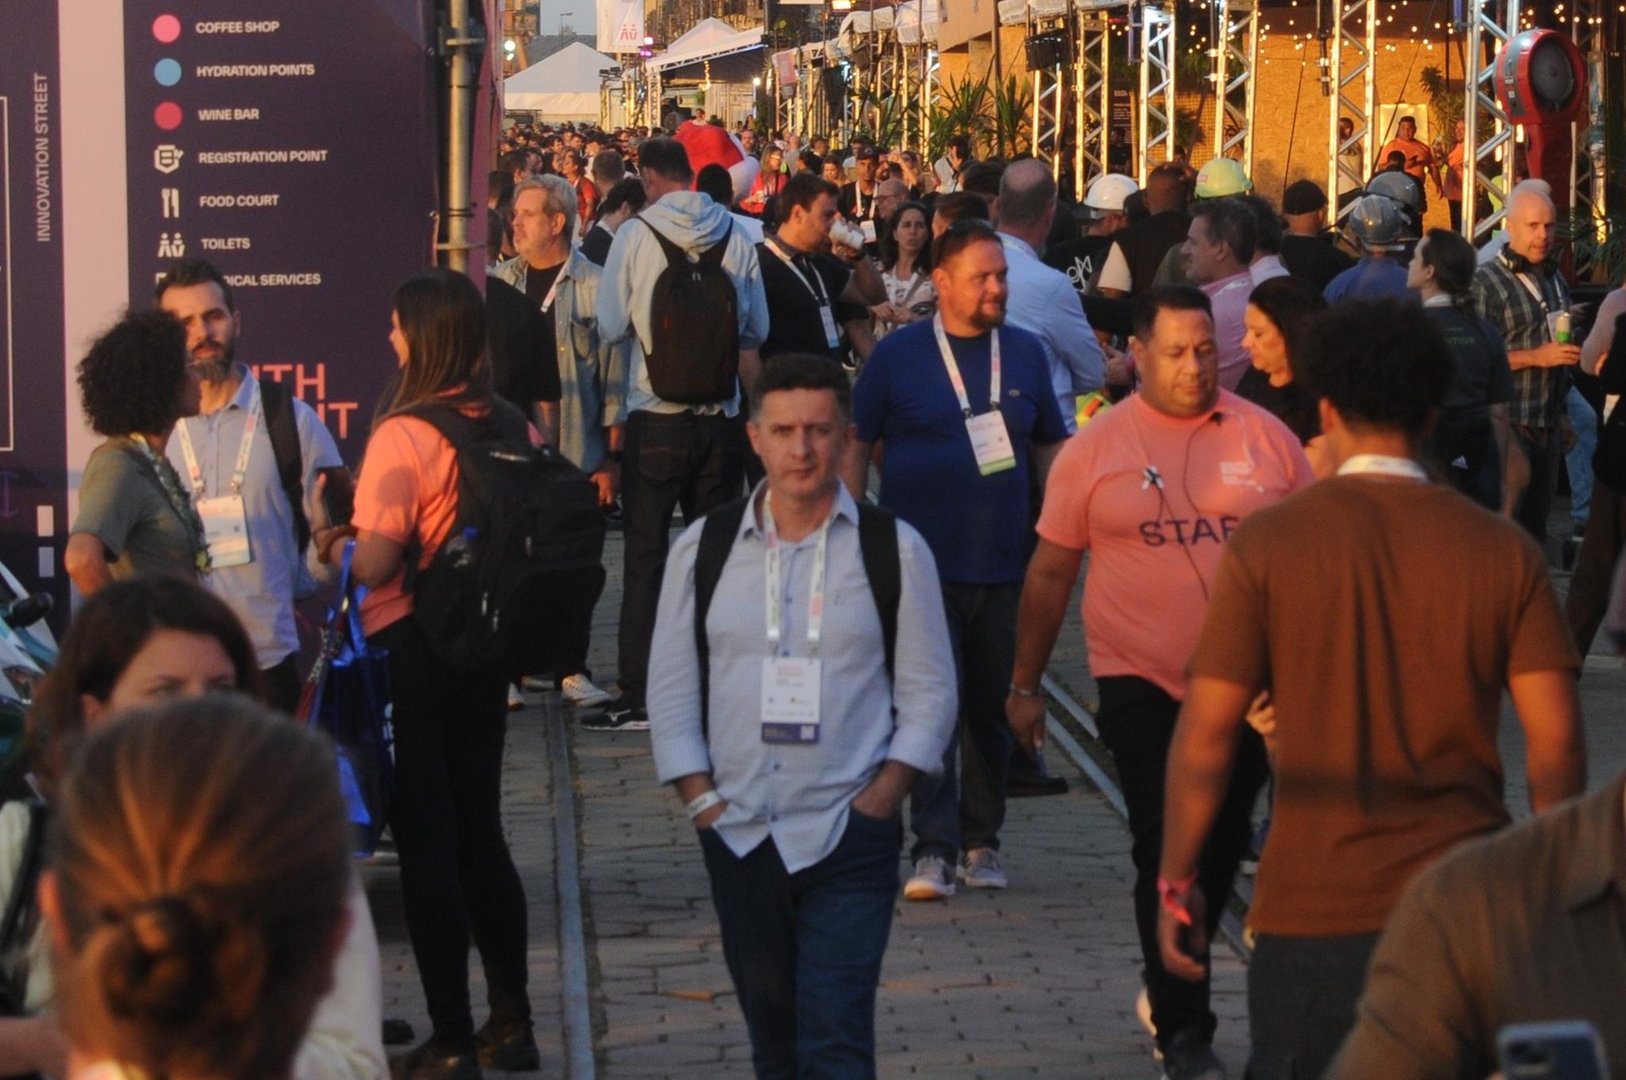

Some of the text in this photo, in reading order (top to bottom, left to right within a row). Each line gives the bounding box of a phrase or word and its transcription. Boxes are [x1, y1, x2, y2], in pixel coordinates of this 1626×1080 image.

[196, 21, 280, 34] COFFEE SHOP
[196, 64, 315, 78] HYDRATION POINTS
[198, 108, 260, 121] WINE BAR
[33, 73, 51, 242] INNOVATION STREET
[198, 150, 328, 164] REGISTRATION POINT
[199, 194, 280, 207] FOOD COURT
[201, 238, 251, 250] TOILETS
[260, 273, 322, 286] SERVICES
[1138, 516, 1241, 546] STAF
